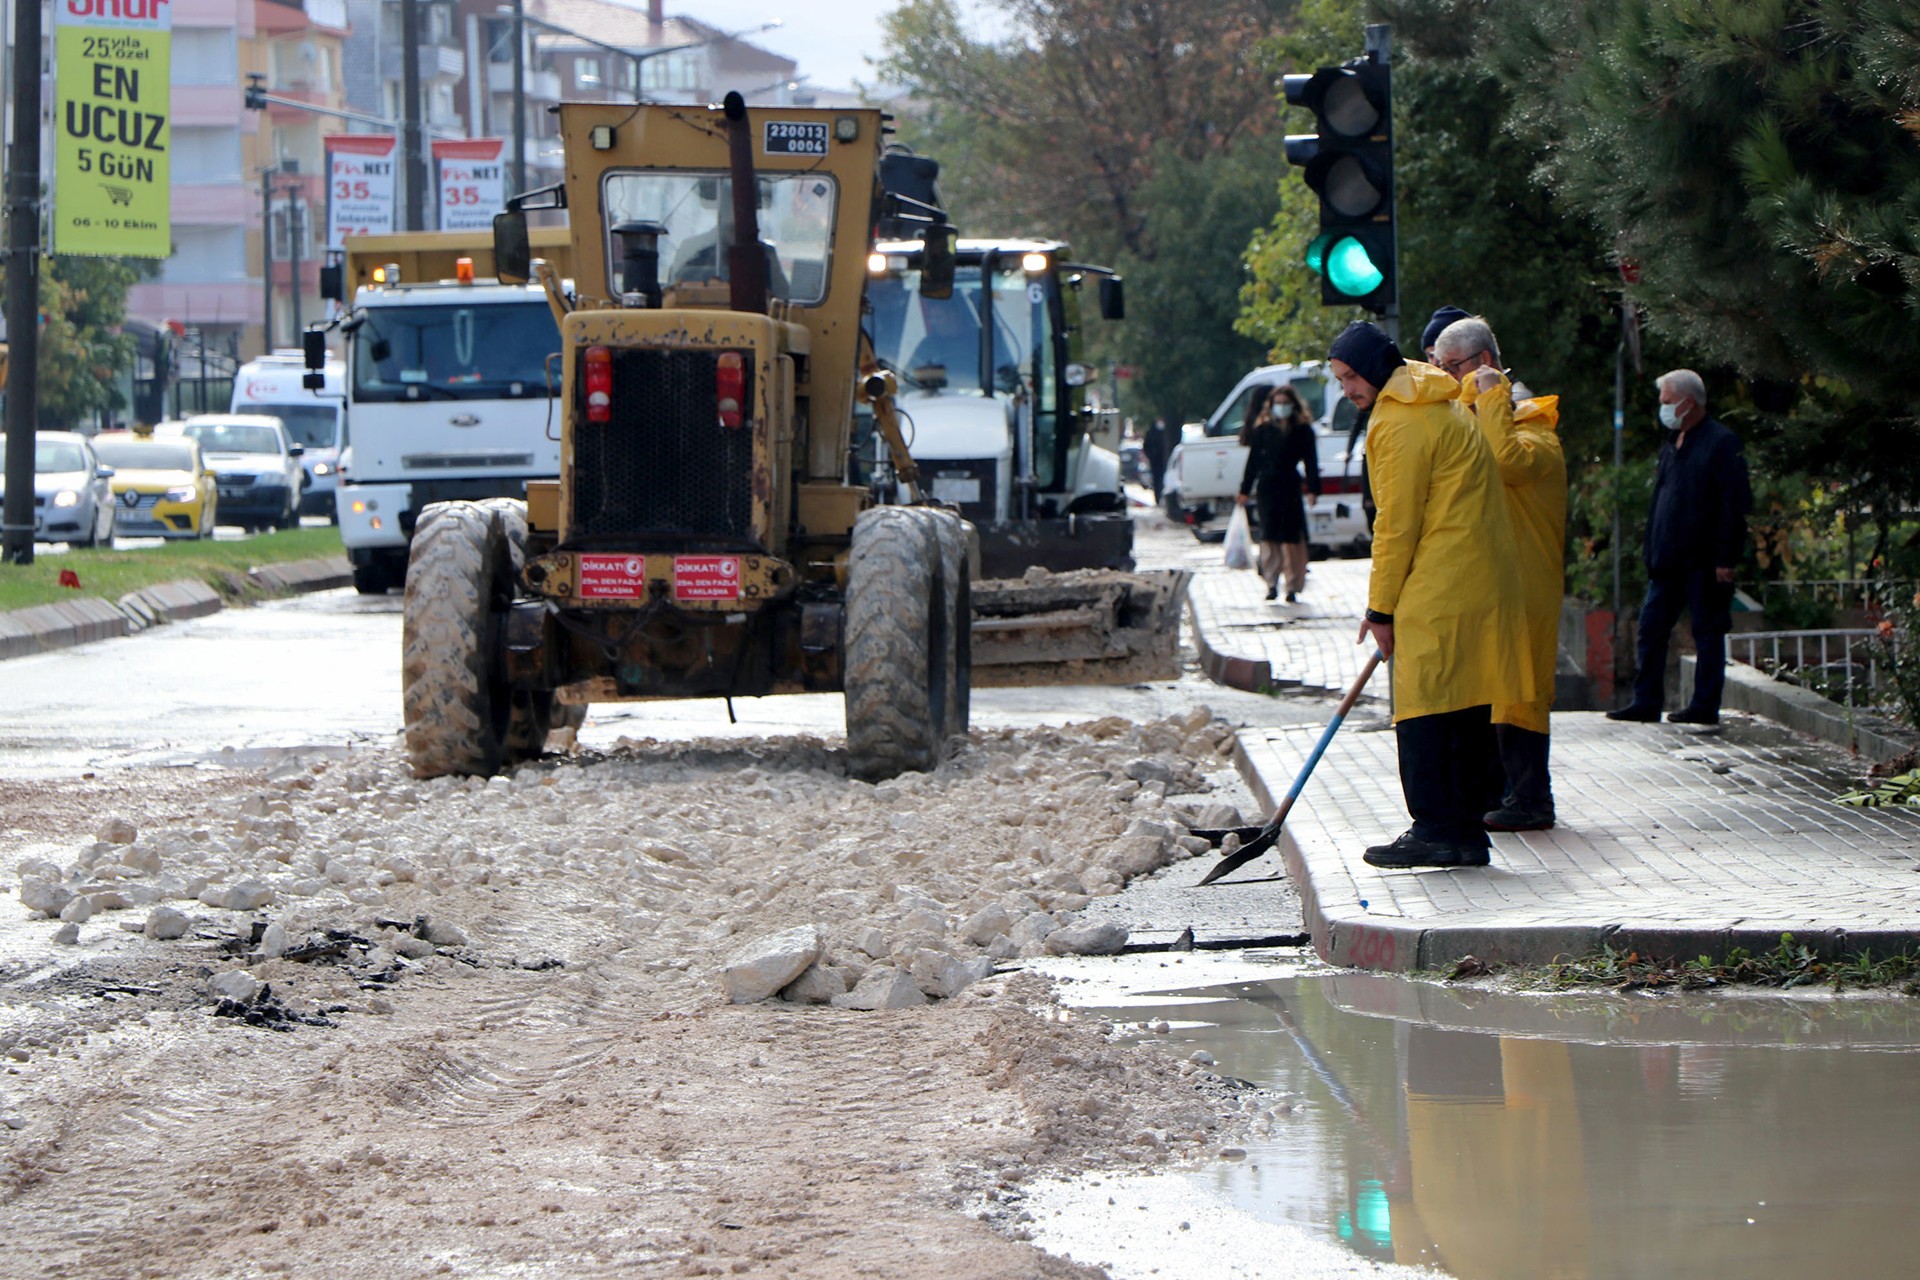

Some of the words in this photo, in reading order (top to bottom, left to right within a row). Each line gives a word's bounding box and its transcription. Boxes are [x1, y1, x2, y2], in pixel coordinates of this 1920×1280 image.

[116, 48, 150, 60] özel
[93, 62, 139, 102] EN
[66, 100, 166, 152] UCUZ
[770, 124, 824, 139] 220013
[788, 140, 823, 152] 0004
[78, 148, 92, 172] 5
[335, 181, 370, 200] 35
[445, 186, 480, 206] 35
[73, 217, 91, 228] 06
[105, 218, 119, 229] 10
[124, 219, 158, 231] Ekim
[1029, 282, 1043, 304] 6
[600, 577, 617, 585] DEN
[618, 578, 643, 586] FAZLA
[695, 579, 712, 587] DEN
[712, 579, 737, 587] FAZLA
[1349, 924, 1395, 971] 200
